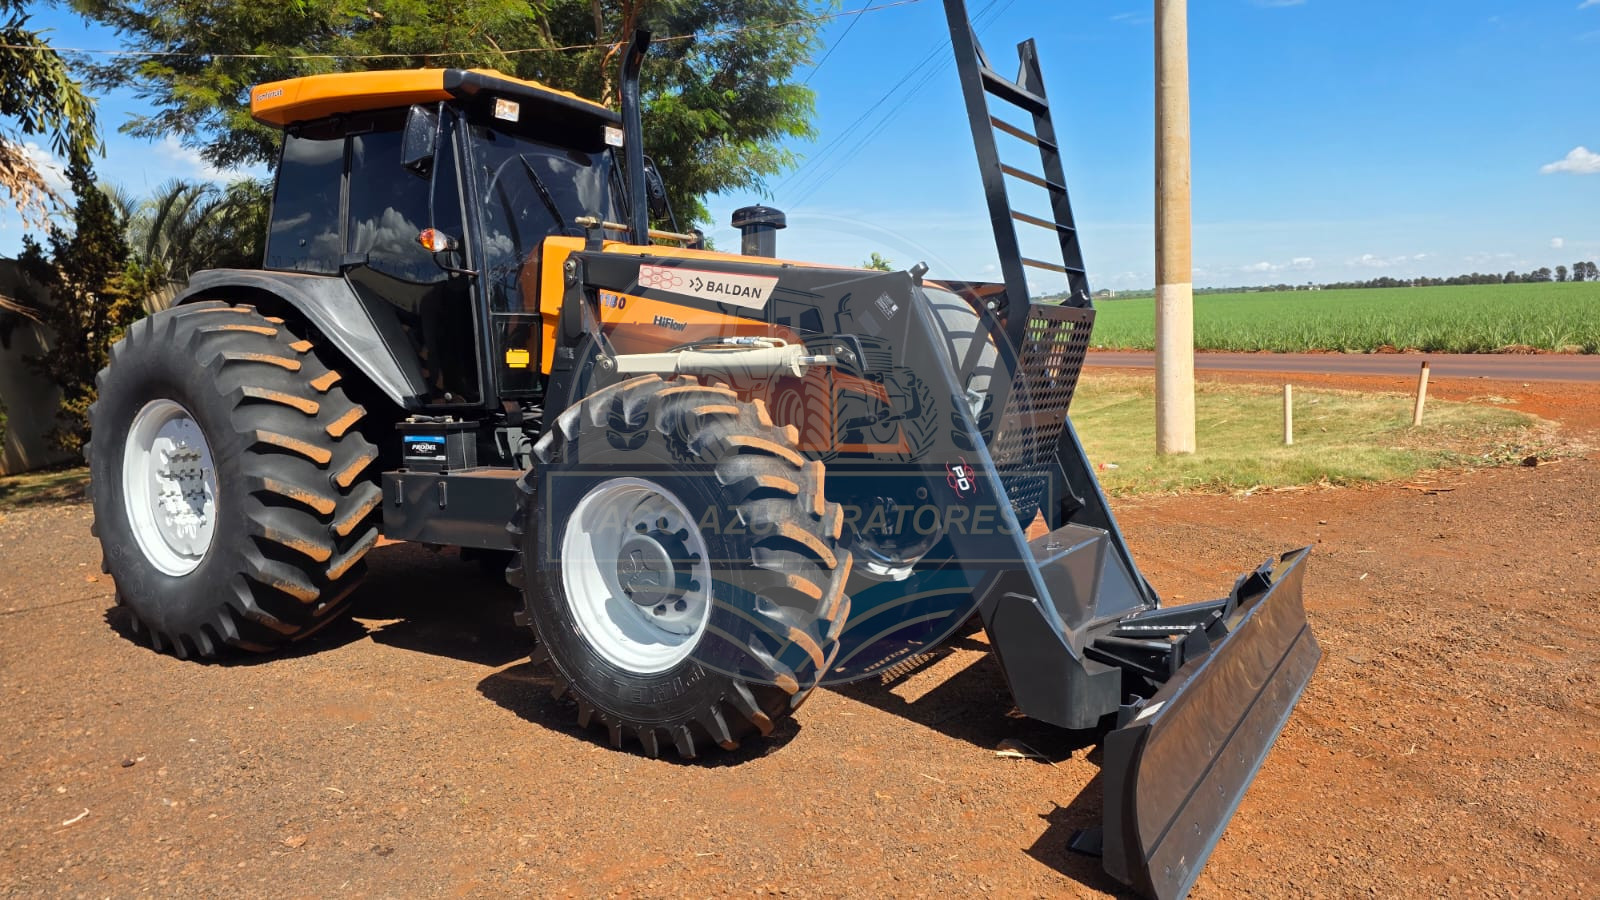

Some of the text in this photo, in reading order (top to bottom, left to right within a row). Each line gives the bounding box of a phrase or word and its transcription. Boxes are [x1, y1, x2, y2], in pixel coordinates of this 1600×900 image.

[706, 281, 762, 299] BALDAN
[653, 315, 688, 332] HiFlow
[952, 465, 970, 491] PD
